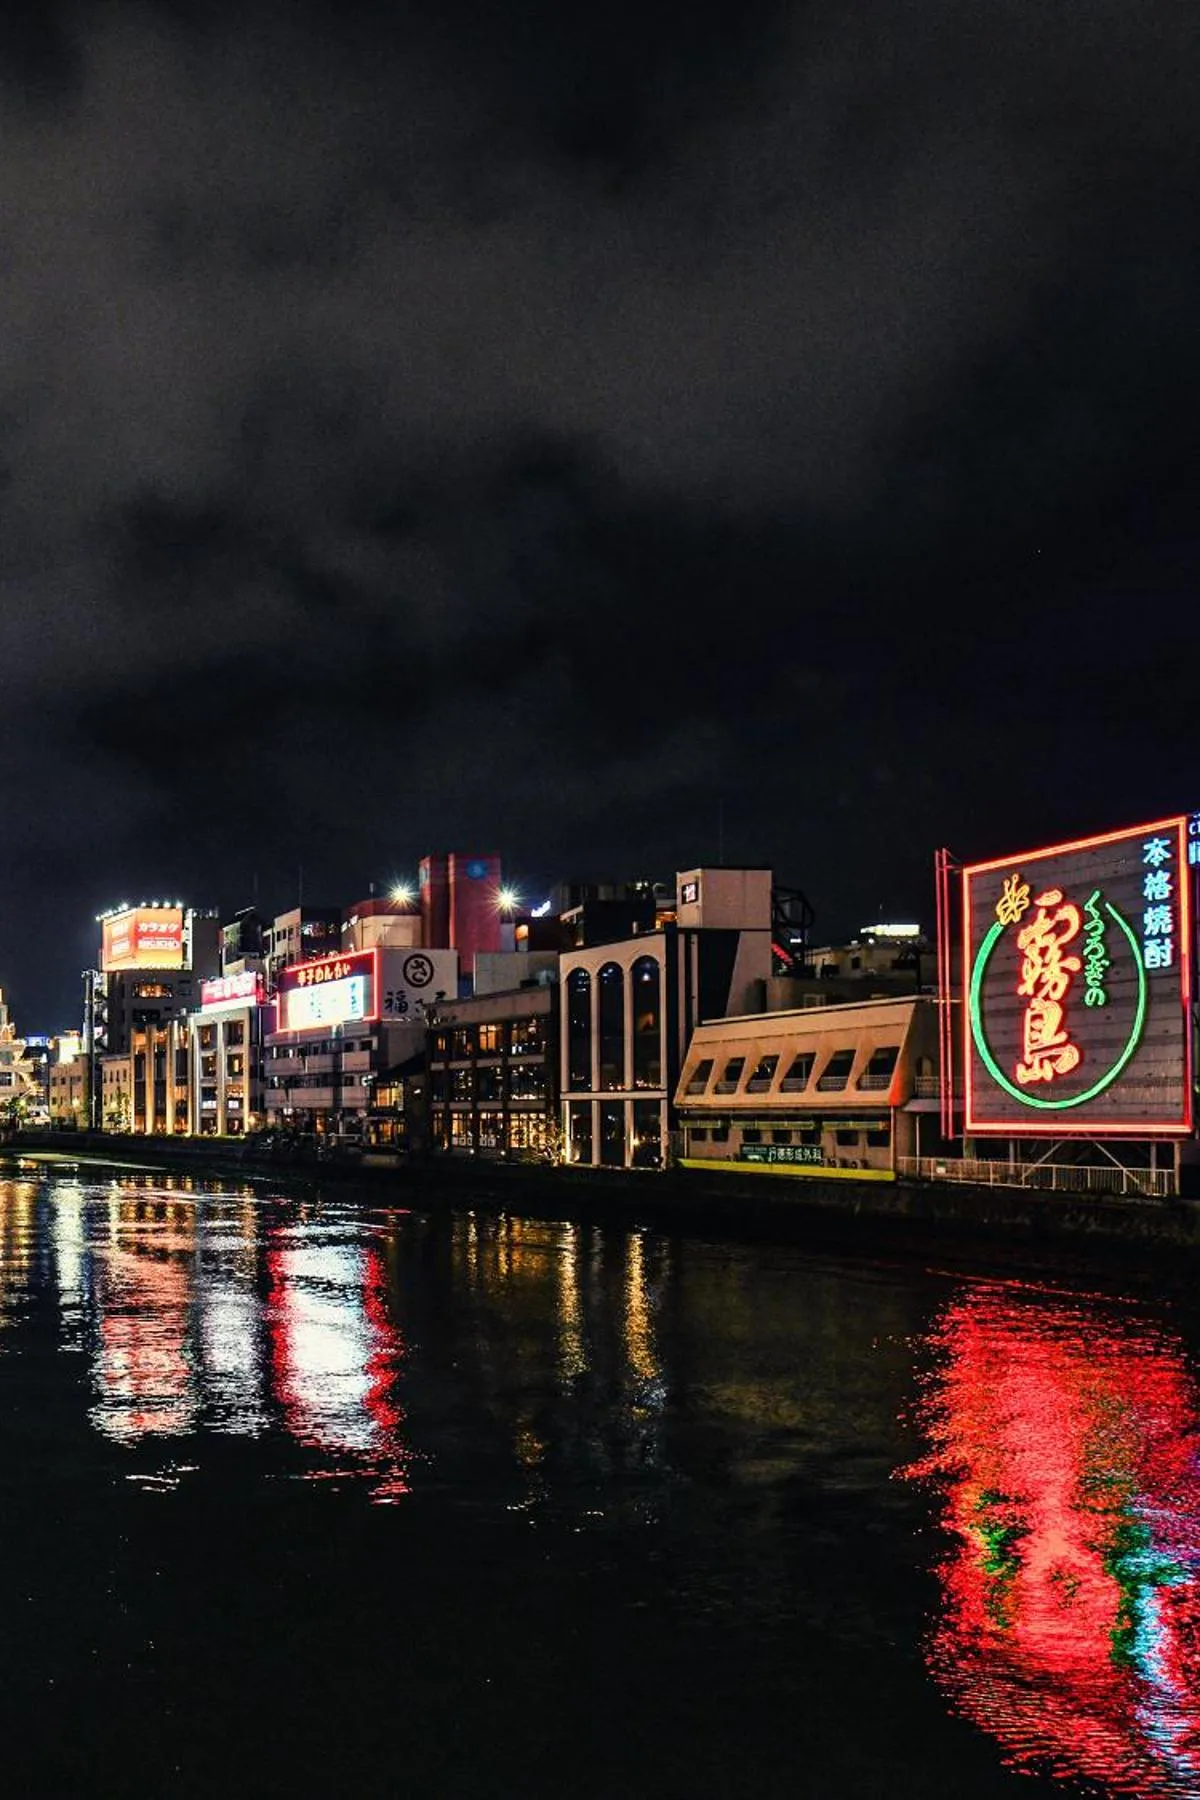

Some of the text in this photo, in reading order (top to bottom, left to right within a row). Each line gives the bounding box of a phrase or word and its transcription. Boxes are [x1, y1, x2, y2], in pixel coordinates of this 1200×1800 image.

[1142, 837, 1174, 969] 本格焼酎
[1016, 888, 1081, 1084] 霧島
